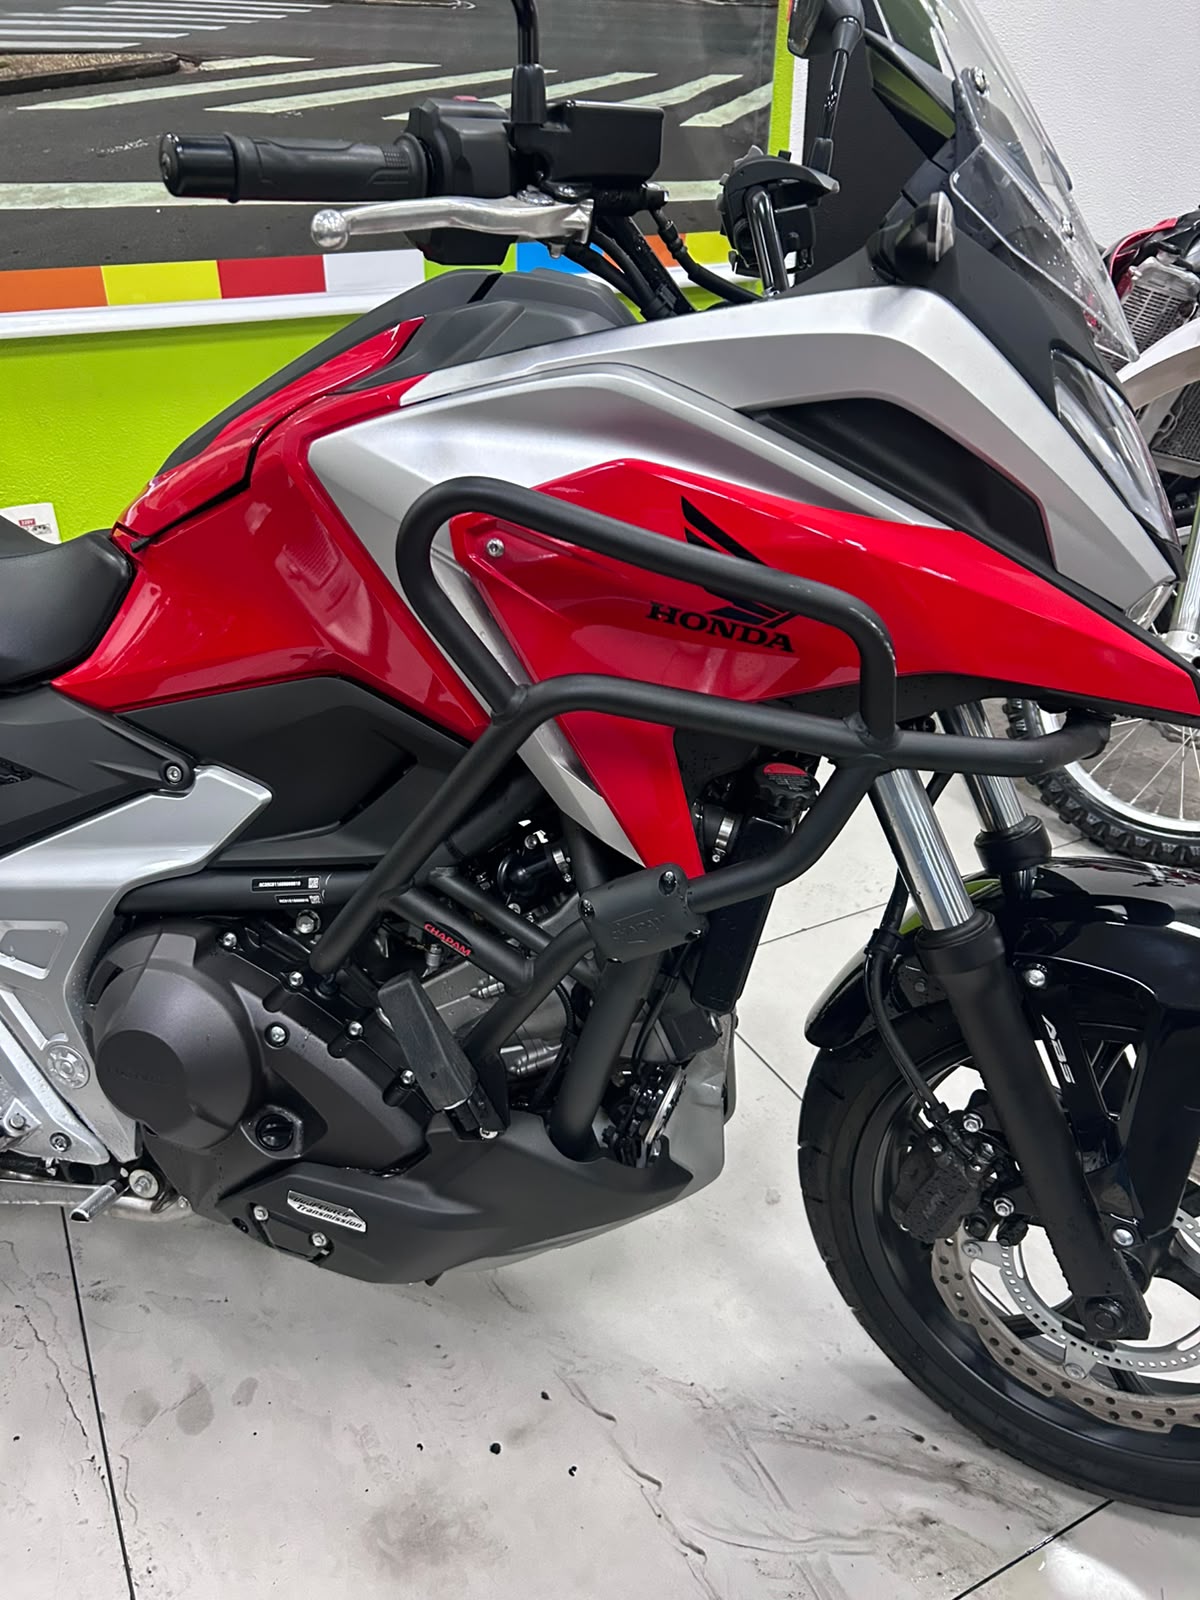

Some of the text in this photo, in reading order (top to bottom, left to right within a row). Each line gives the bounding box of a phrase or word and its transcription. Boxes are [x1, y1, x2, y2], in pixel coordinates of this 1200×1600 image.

[645, 600, 794, 653] HONDA
[423, 923, 472, 957] CHAPAM
[1041, 1014, 1076, 1084] ABS
[296, 1203, 363, 1229] Transmission
